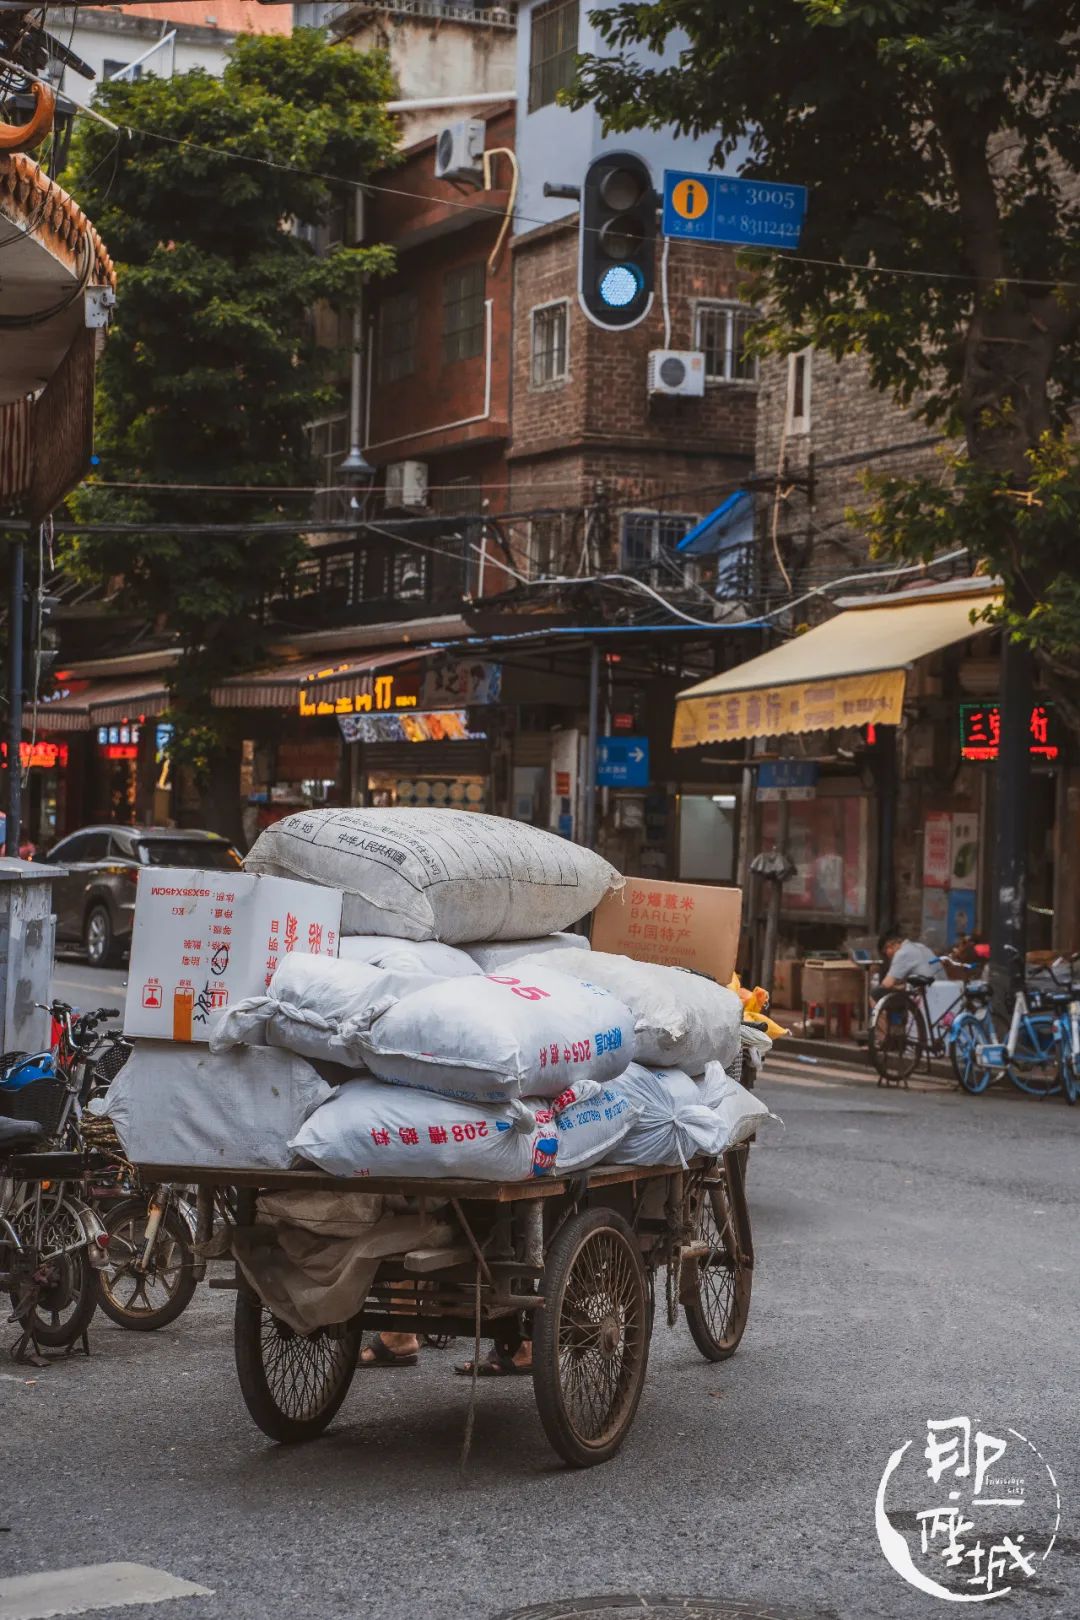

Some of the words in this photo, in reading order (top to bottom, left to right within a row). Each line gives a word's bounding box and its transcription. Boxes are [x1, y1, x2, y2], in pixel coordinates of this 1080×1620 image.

[745, 187, 796, 210] 3005
[337, 832, 407, 866] 中华人民共和国
[630, 908, 693, 926] BARLEY
[627, 923, 692, 943] 中国特产
